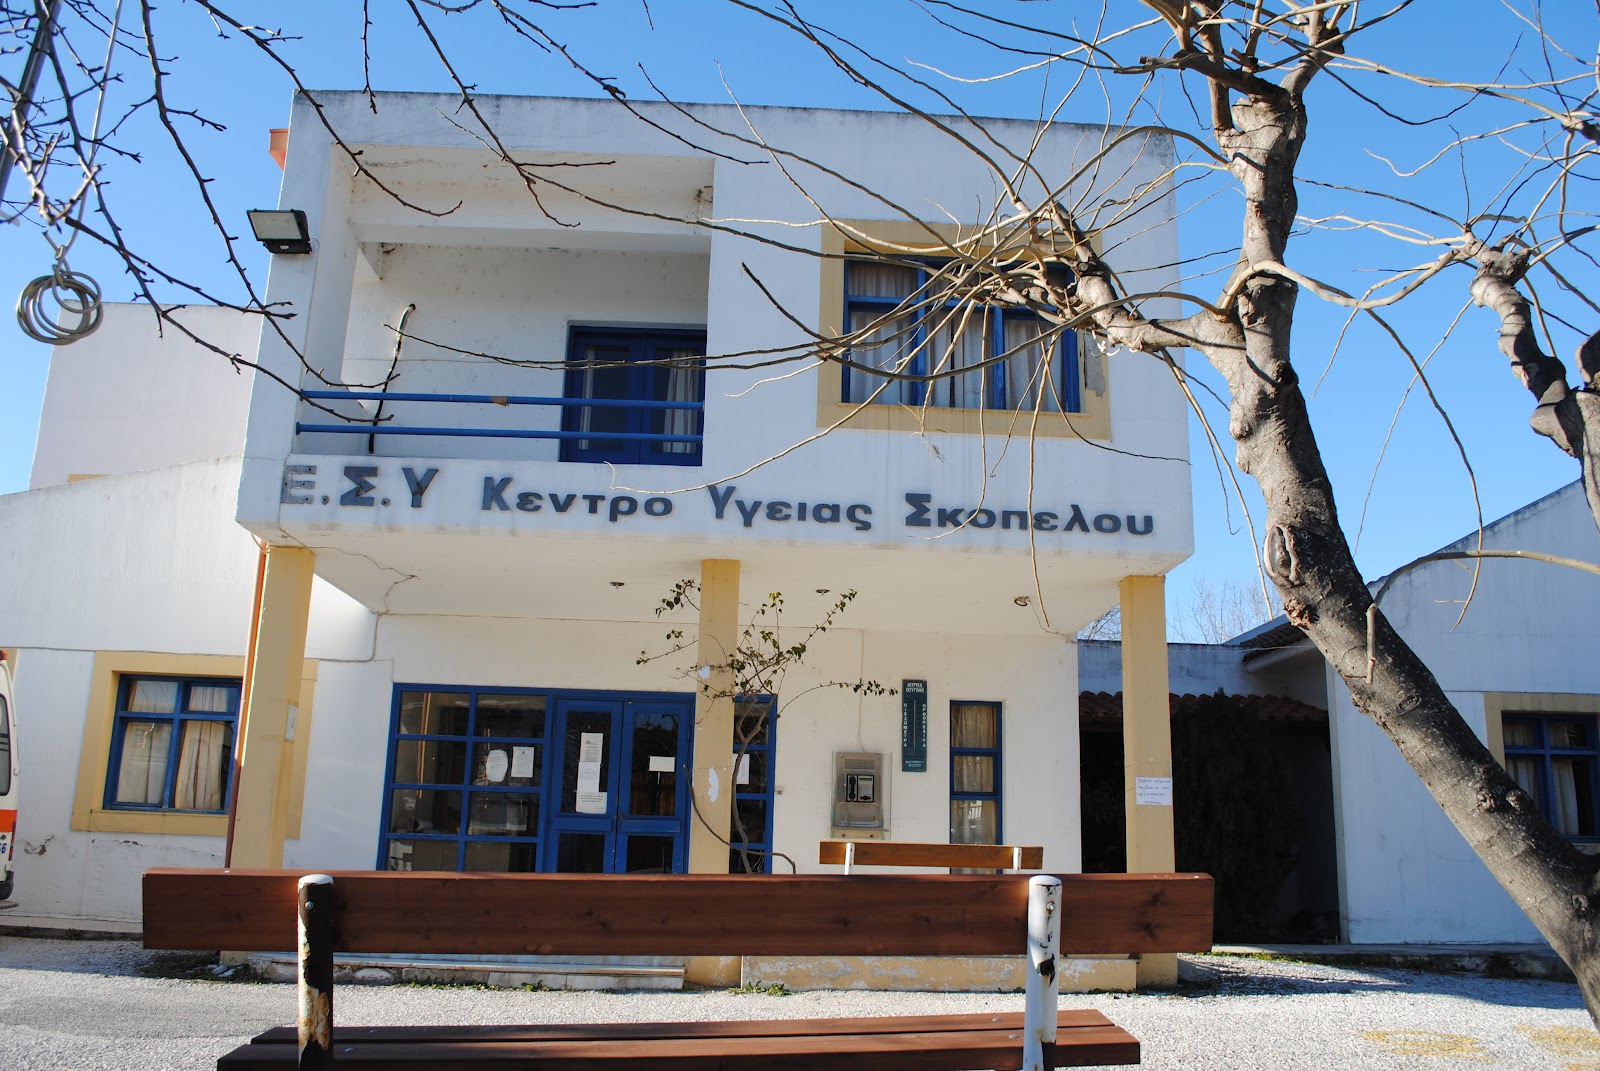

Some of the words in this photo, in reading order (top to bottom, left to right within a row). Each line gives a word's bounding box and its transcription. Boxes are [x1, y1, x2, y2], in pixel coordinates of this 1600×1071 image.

[482, 476, 673, 522] Κεντρο
[707, 485, 873, 531] Υγειας
[905, 492, 1153, 535] Σκοπελου
